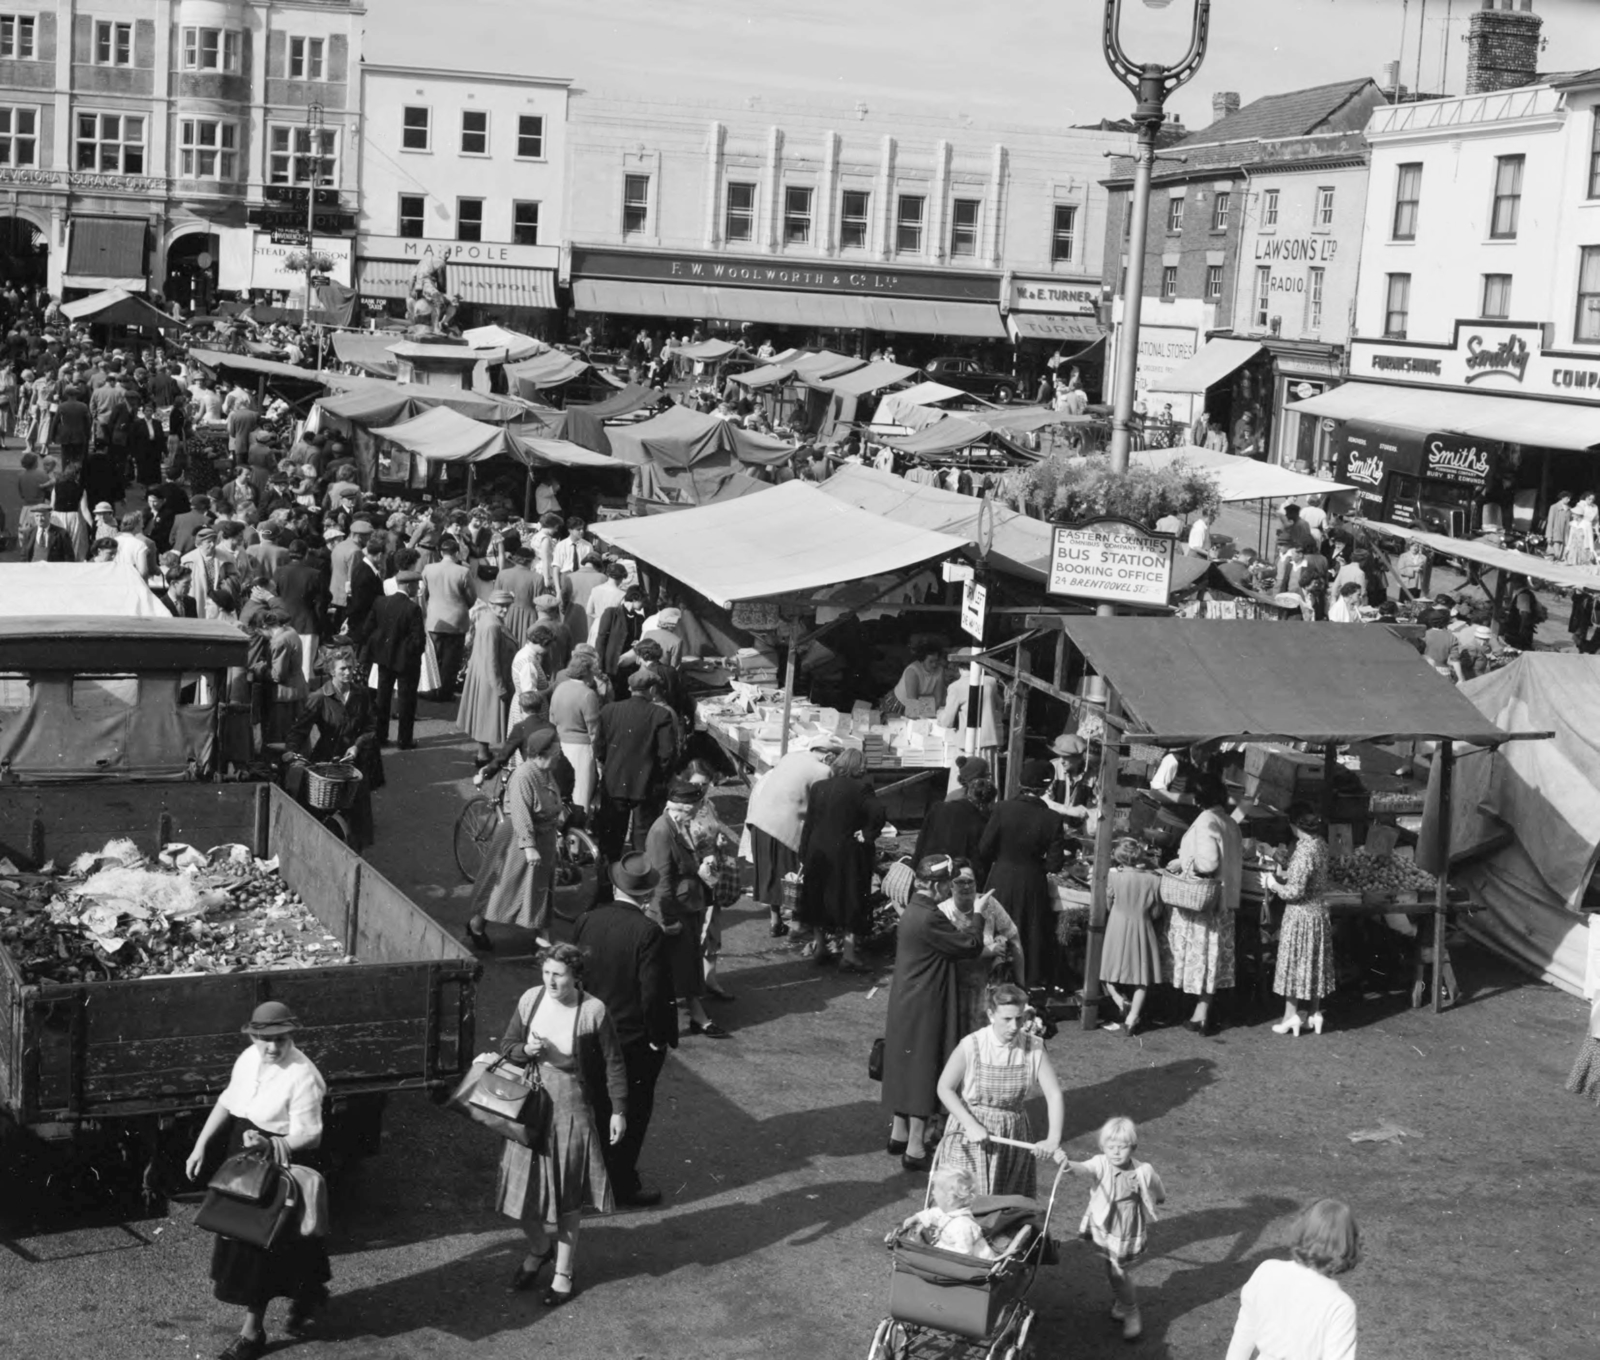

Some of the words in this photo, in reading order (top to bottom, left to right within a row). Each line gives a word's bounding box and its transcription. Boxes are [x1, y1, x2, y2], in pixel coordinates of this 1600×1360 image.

[12, 170, 61, 183] VICTORIA
[64, 173, 121, 187] NSURANCE
[126, 177, 167, 189] OFFICES
[266, 213, 338, 226] SIMPON
[271, 232, 305, 240] CNVENIENCES
[254, 248, 286, 256] STEAD
[300, 249, 348, 260] SPSON
[404, 243, 508, 260] MAPOLE
[1255, 237, 1317, 260] LAWSON'S
[672, 262, 681, 275] F.
[691, 263, 704, 276] W.
[713, 265, 823, 284] WOOLWORTH
[832, 276, 840, 284] &
[460, 280, 542, 293] MAYPOLE
[376, 298, 387, 306] FOR
[1029, 291, 1036, 299] &
[1048, 289, 1091, 302] TURNER
[1024, 322, 1108, 335] TURNER
[1167, 343, 1193, 360] STORES
[1371, 354, 1442, 376] FURNISHING
[1426, 470, 1443, 478] BURY
[1057, 529, 1110, 544] EASTERN
[1114, 534, 1168, 554] COUNTIES
[1069, 539, 1100, 548] OMNIBUS
[1104, 543, 1137, 551] COMPANY
[1058, 547, 1090, 561] BUS
[1100, 551, 1167, 569] STATION
[1056, 562, 1113, 577] BOOKING
[1118, 568, 1164, 583] OFFICE
[1055, 576, 1067, 585] 24
[1069, 577, 1132, 592] BRENTGOVEL
